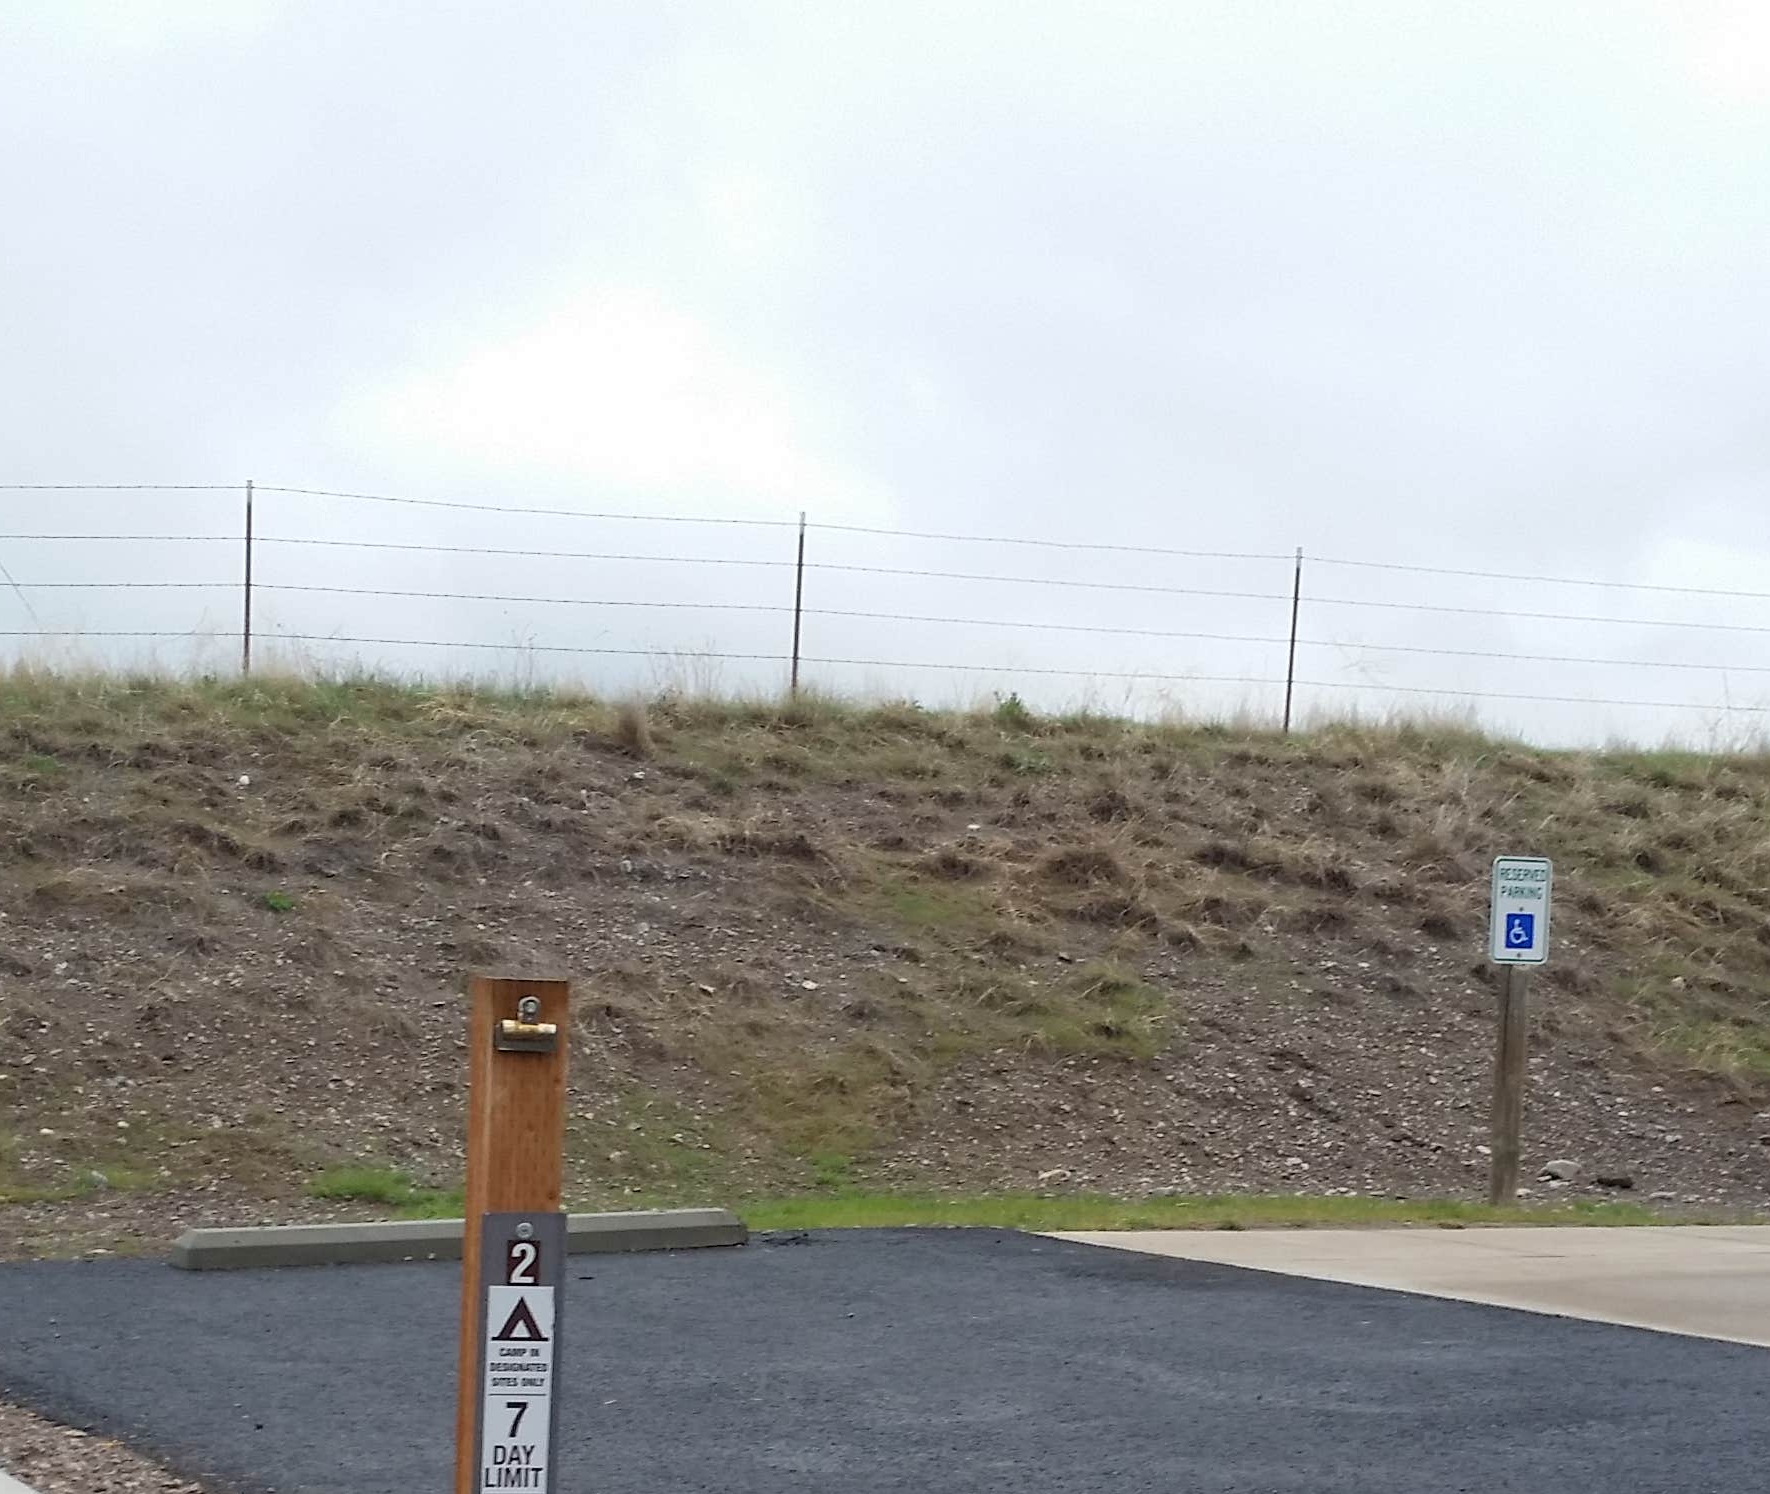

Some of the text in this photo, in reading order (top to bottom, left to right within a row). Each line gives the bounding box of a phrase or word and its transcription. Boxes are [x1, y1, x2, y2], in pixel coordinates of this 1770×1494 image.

[509, 1242, 538, 1284] 2
[505, 1401, 528, 1438] 7
[492, 1445, 536, 1466] DAY
[484, 1467, 544, 1489] LIMIT
